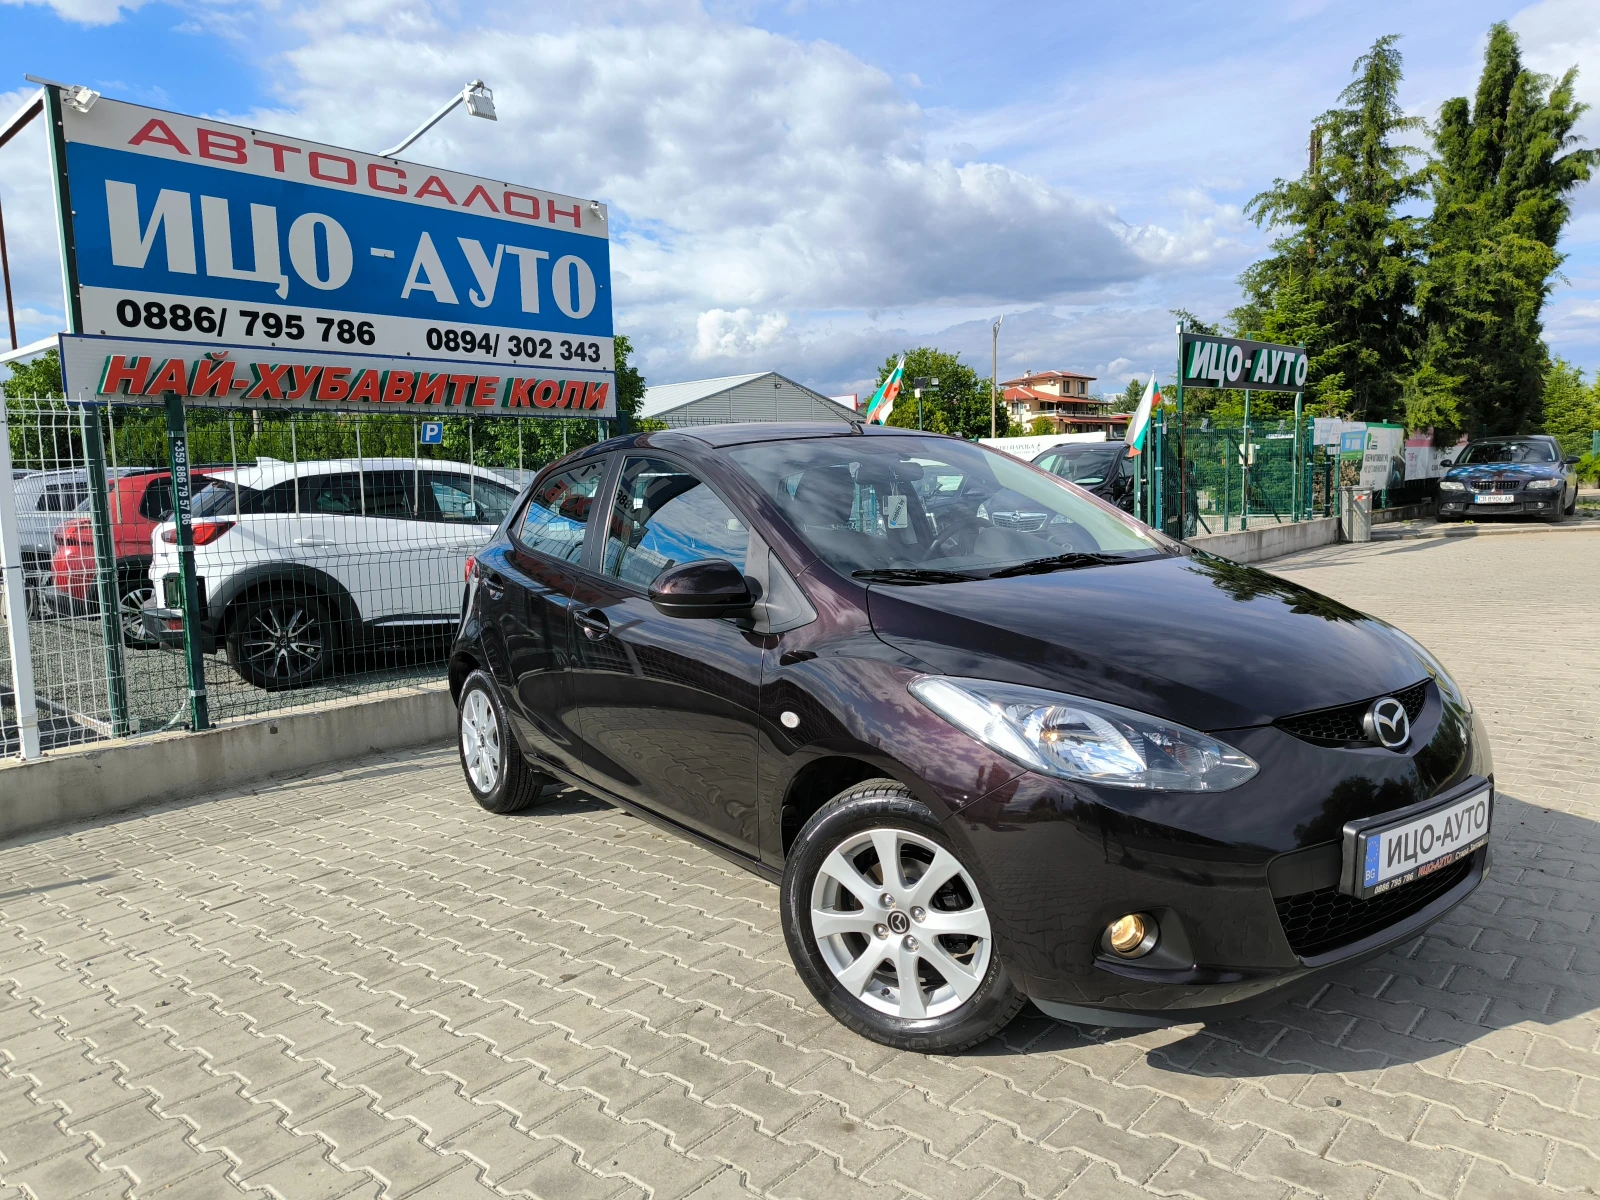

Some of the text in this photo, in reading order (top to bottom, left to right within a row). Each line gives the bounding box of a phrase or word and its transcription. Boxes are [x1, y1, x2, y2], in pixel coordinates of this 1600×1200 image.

[128, 118, 583, 229] АВТОСАЛОН
[116, 298, 601, 364] 0886/ 795 786 0894/ 302 343
[100, 350, 610, 410] НАЙ-ХУБАВИТЕ КОЛИ
[175, 440, 191, 525] +359 886 79 57 86
[1386, 800, 1486, 868] ИЦО-АУТО
[1365, 868, 1376, 881] BG
[1374, 881, 1390, 894] 0886
[1391, 878, 1402, 888] 795
[1403, 872, 1414, 883] 786
